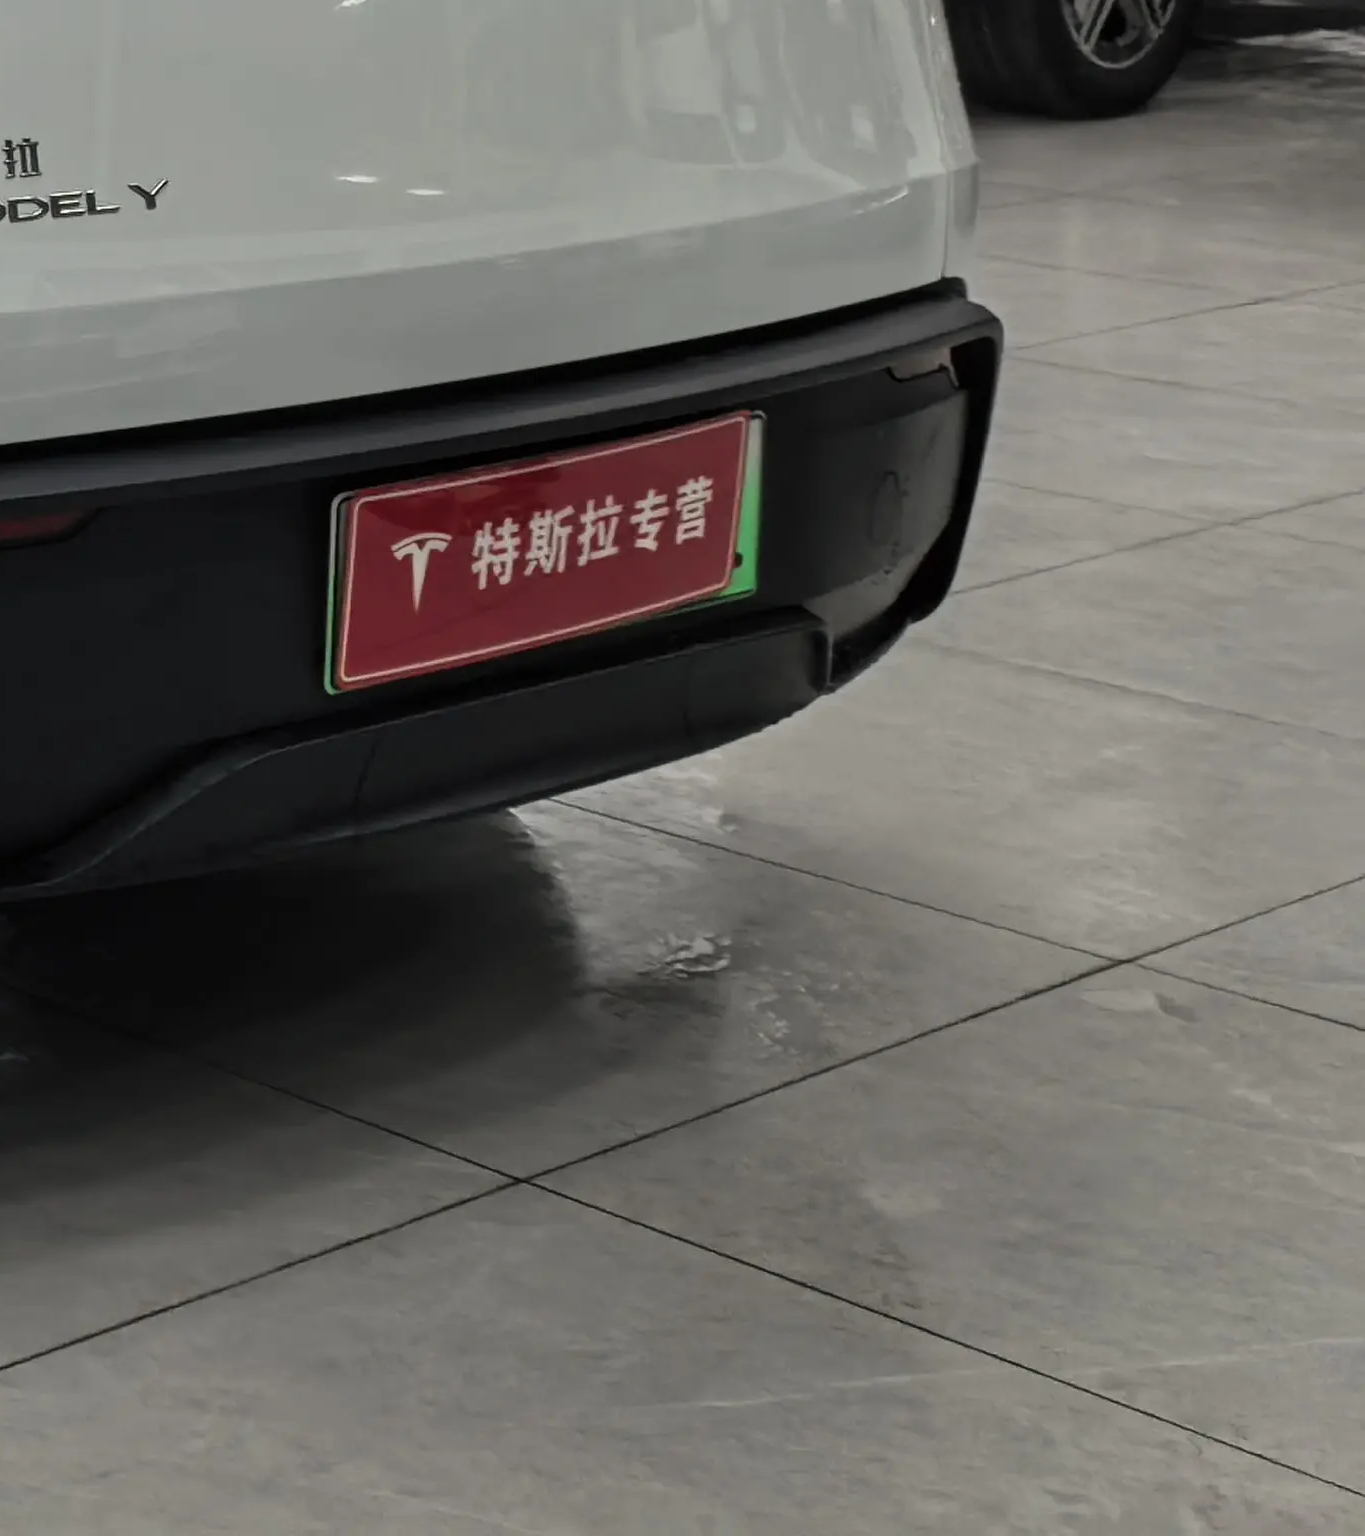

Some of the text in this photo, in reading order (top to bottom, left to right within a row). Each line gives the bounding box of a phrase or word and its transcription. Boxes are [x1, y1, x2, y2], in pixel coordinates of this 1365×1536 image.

[127, 178, 170, 211] Y
[470, 475, 714, 591] 特斯拉专营
